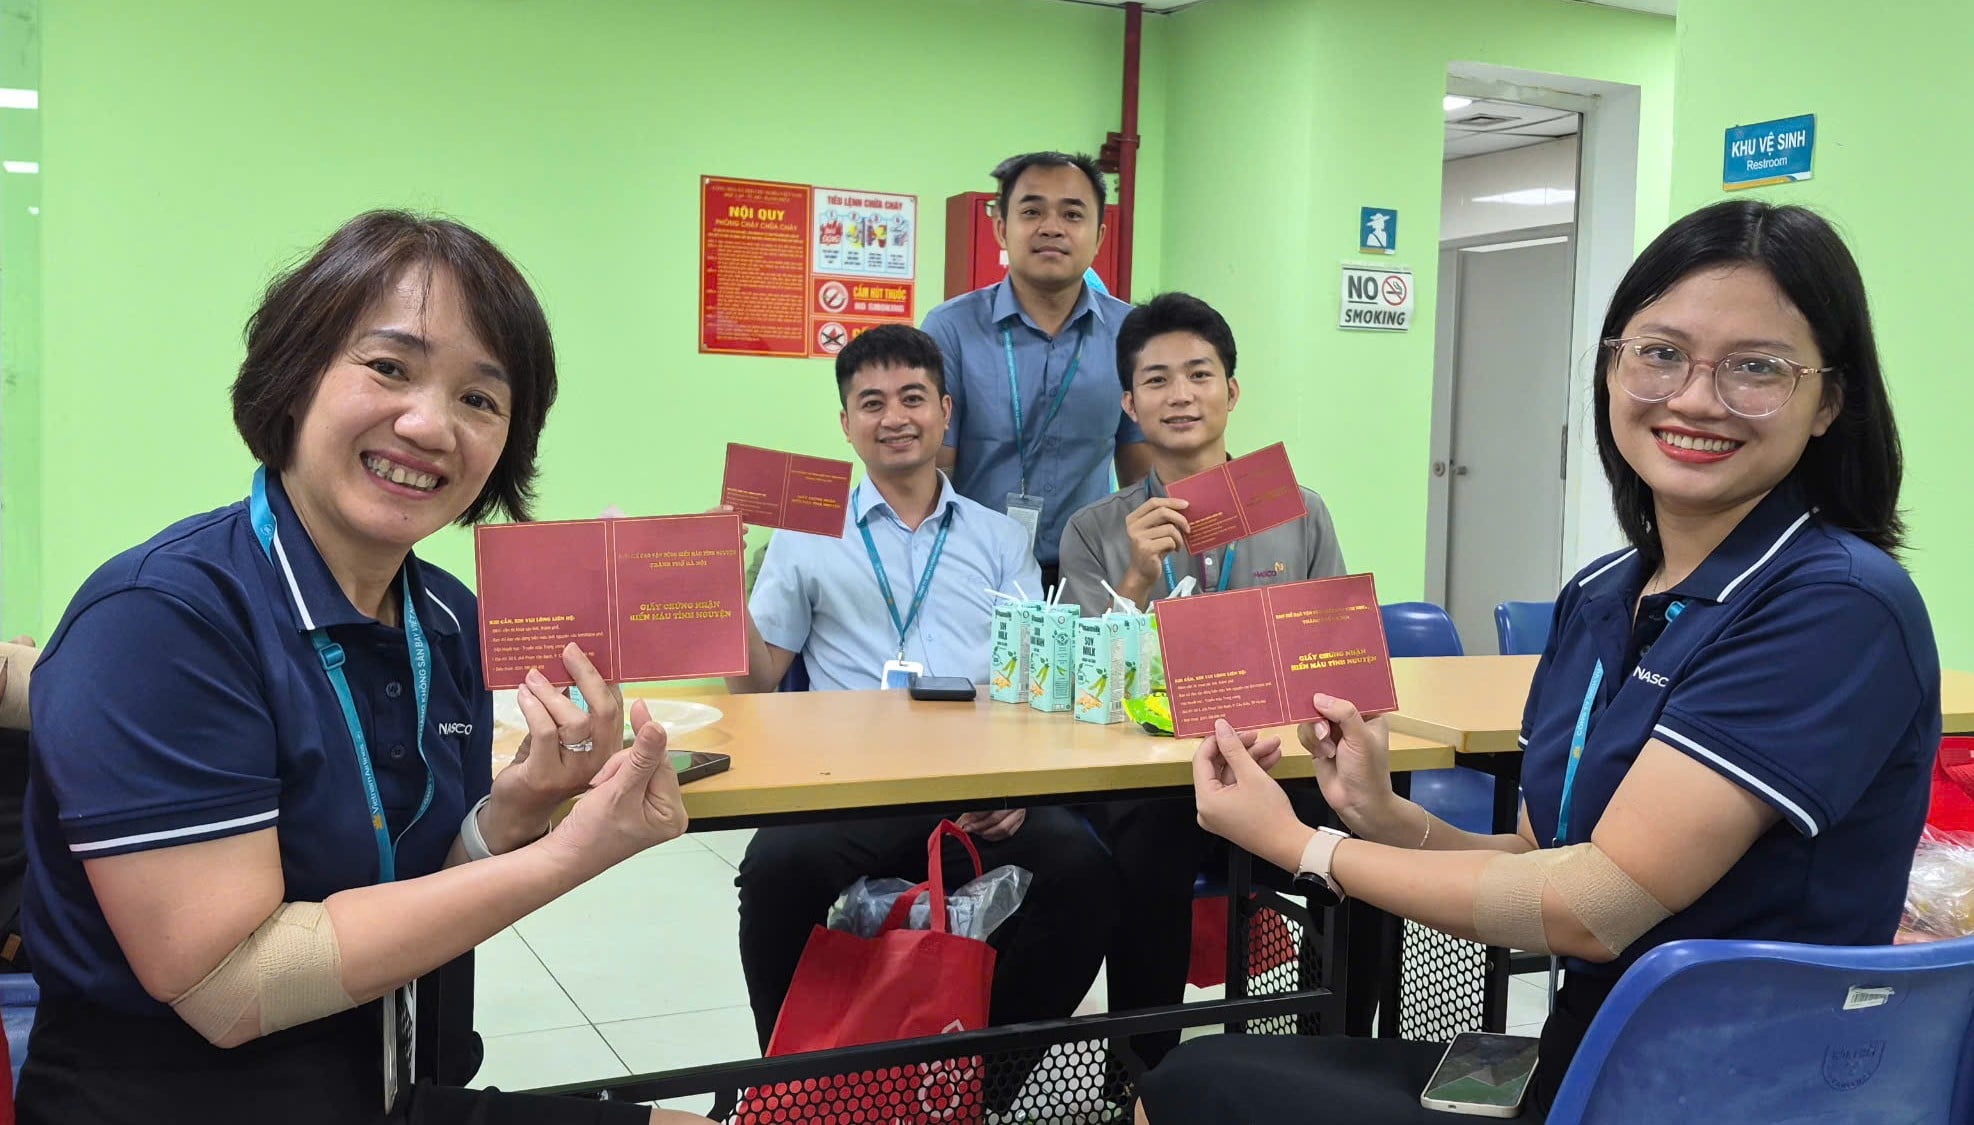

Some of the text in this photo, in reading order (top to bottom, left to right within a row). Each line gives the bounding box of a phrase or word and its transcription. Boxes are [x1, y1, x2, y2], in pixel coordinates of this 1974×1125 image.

[1731, 129, 1806, 158] KHU VỆ SINH
[1746, 157, 1788, 171] Restroom
[728, 204, 785, 221] NỘI QUY
[741, 220, 759, 228] CHÁY
[781, 223, 798, 231] CHÁY
[1348, 275, 1378, 300] NO
[1345, 309, 1406, 326] SMOKING
[640, 599, 720, 611] GIẤY CHỨNG NHẬN
[630, 609, 731, 621] HIẾN MÁU TÌNH NGUYỆN
[411, 632, 424, 648] BAY
[1085, 636, 1094, 646] SOY
[1083, 645, 1095, 656] MILK
[1298, 653, 1317, 662] GIẤY
[1319, 651, 1344, 660] CHỨNG
[415, 649, 426, 667] SÂN
[1290, 662, 1309, 672] HIẾN
[1310, 660, 1327, 670] MÁU
[1328, 658, 1346, 667] TÌNH
[1632, 665, 1670, 688] NASC
[438, 722, 473, 736] NASCO
[366, 777, 380, 814] Vietnam
